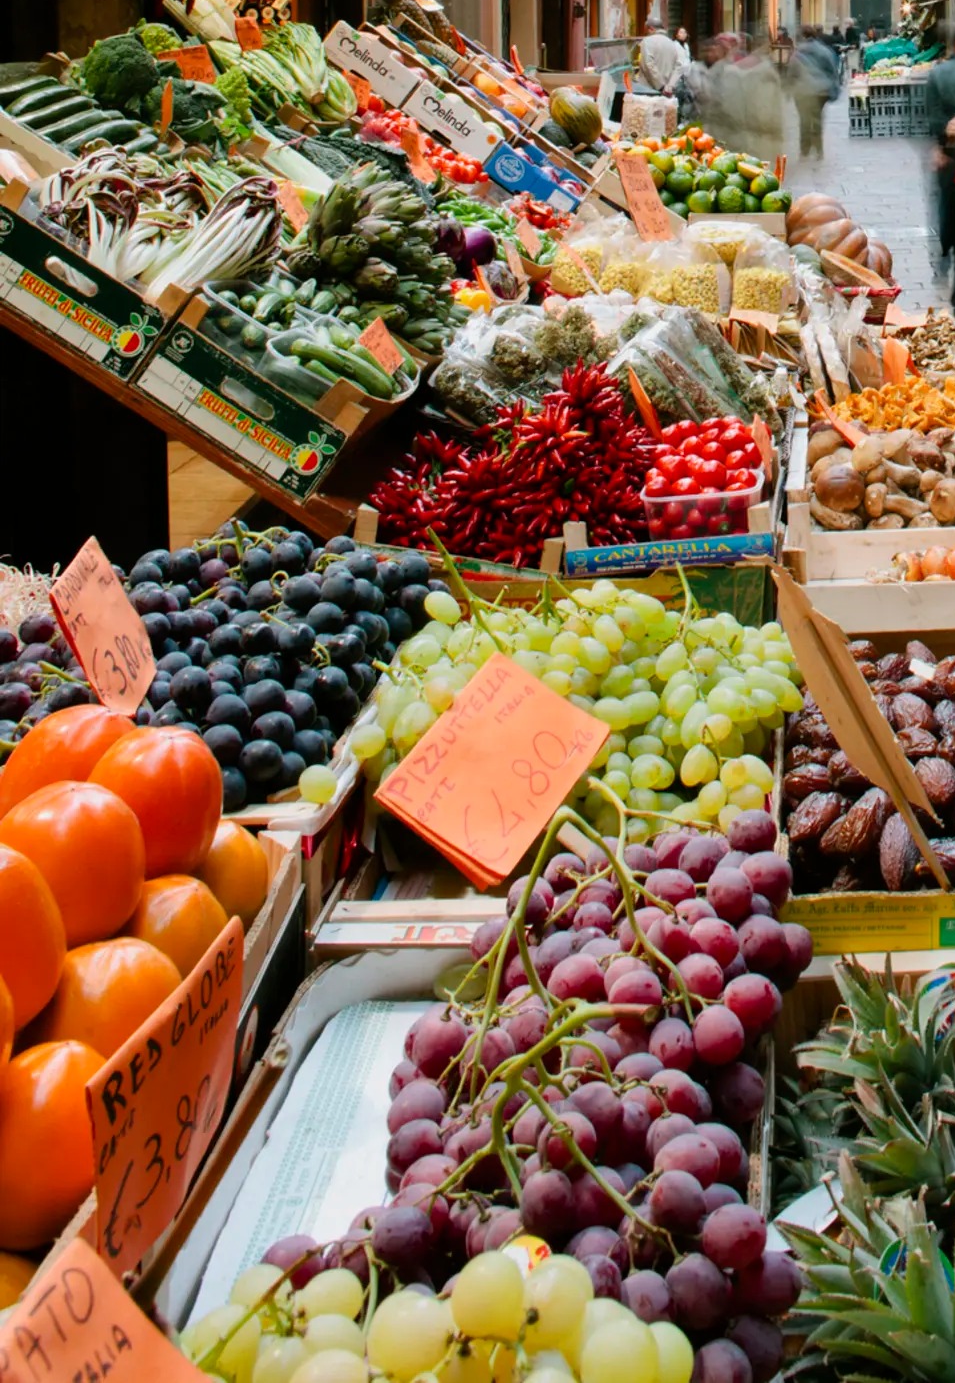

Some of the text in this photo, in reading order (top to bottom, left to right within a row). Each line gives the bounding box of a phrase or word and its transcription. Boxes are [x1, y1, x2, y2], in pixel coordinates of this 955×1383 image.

[340, 37, 388, 78] Melinda
[423, 95, 472, 137] Melinda
[19, 270, 114, 344] FRUTTI di SICILIA
[199, 389, 293, 462] FRUTTI di SICILIA
[593, 541, 732, 564] CANTARELLA
[494, 685, 536, 724] ITALIA
[101, 937, 236, 1125] RED GLOBE
